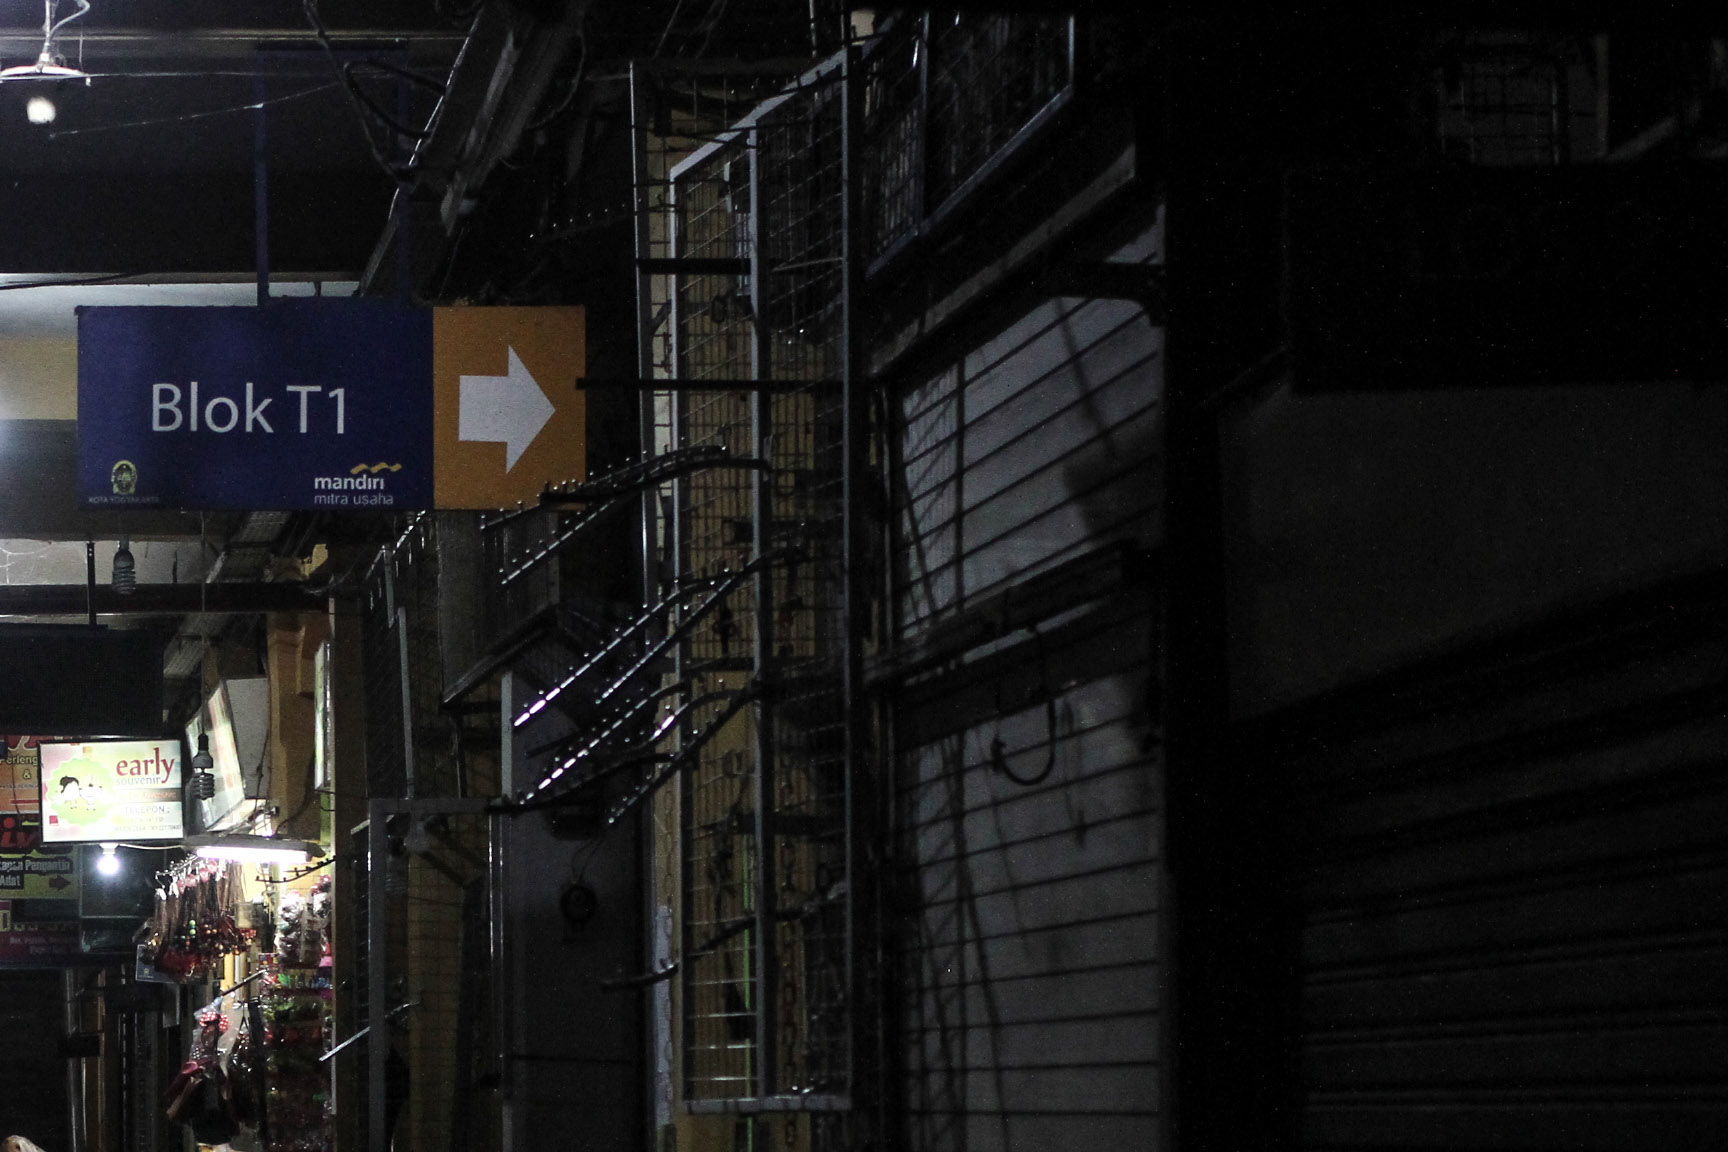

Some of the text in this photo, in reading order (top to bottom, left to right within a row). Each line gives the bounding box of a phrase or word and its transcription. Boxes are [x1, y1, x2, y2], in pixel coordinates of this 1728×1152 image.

[1405, 201, 1579, 281] LOS
[152, 381, 345, 434] Blok T1
[314, 473, 385, 490] mandiri
[314, 492, 394, 505] mitra usaha
[0, 753, 39, 767] Perleng
[116, 747, 176, 784] early
[23, 769, 31, 780] &
[115, 773, 161, 785] souvenir
